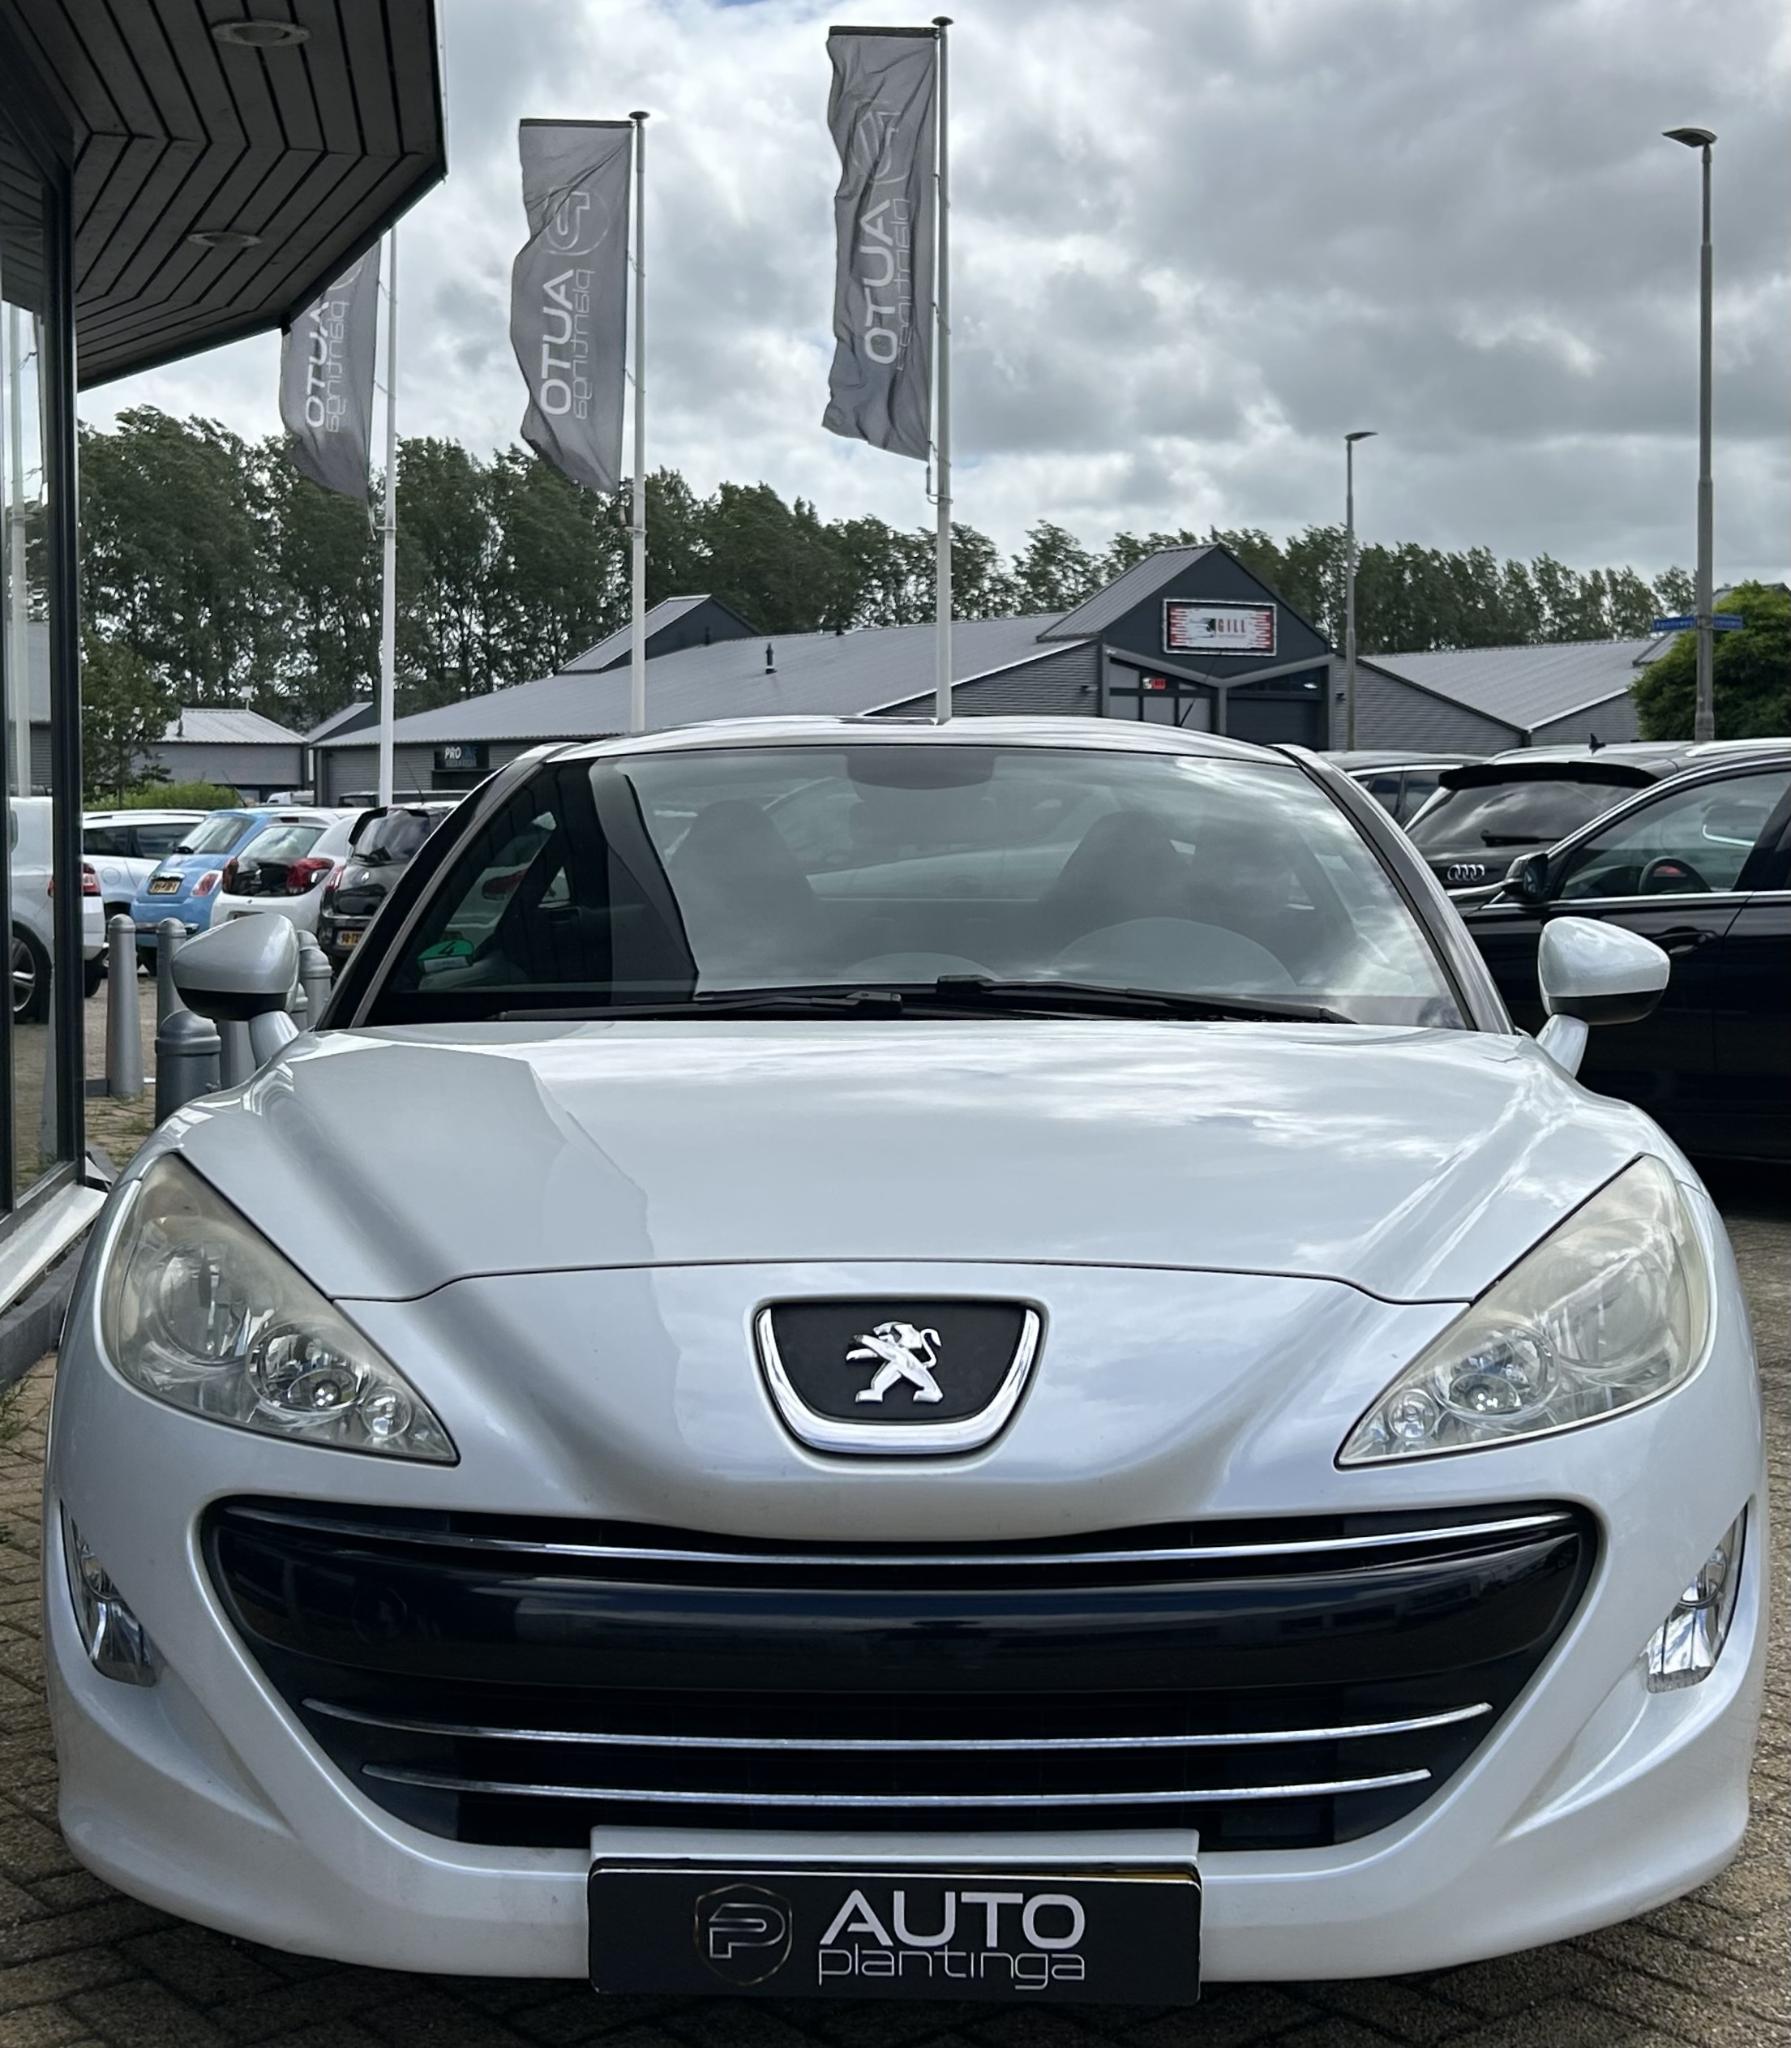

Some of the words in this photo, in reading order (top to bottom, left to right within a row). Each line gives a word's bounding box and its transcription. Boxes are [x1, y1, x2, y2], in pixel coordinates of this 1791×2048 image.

[1217, 618, 1246, 633] GILL
[820, 1889, 1086, 1949] AUTO
[819, 1943, 1087, 1991] plantinga
